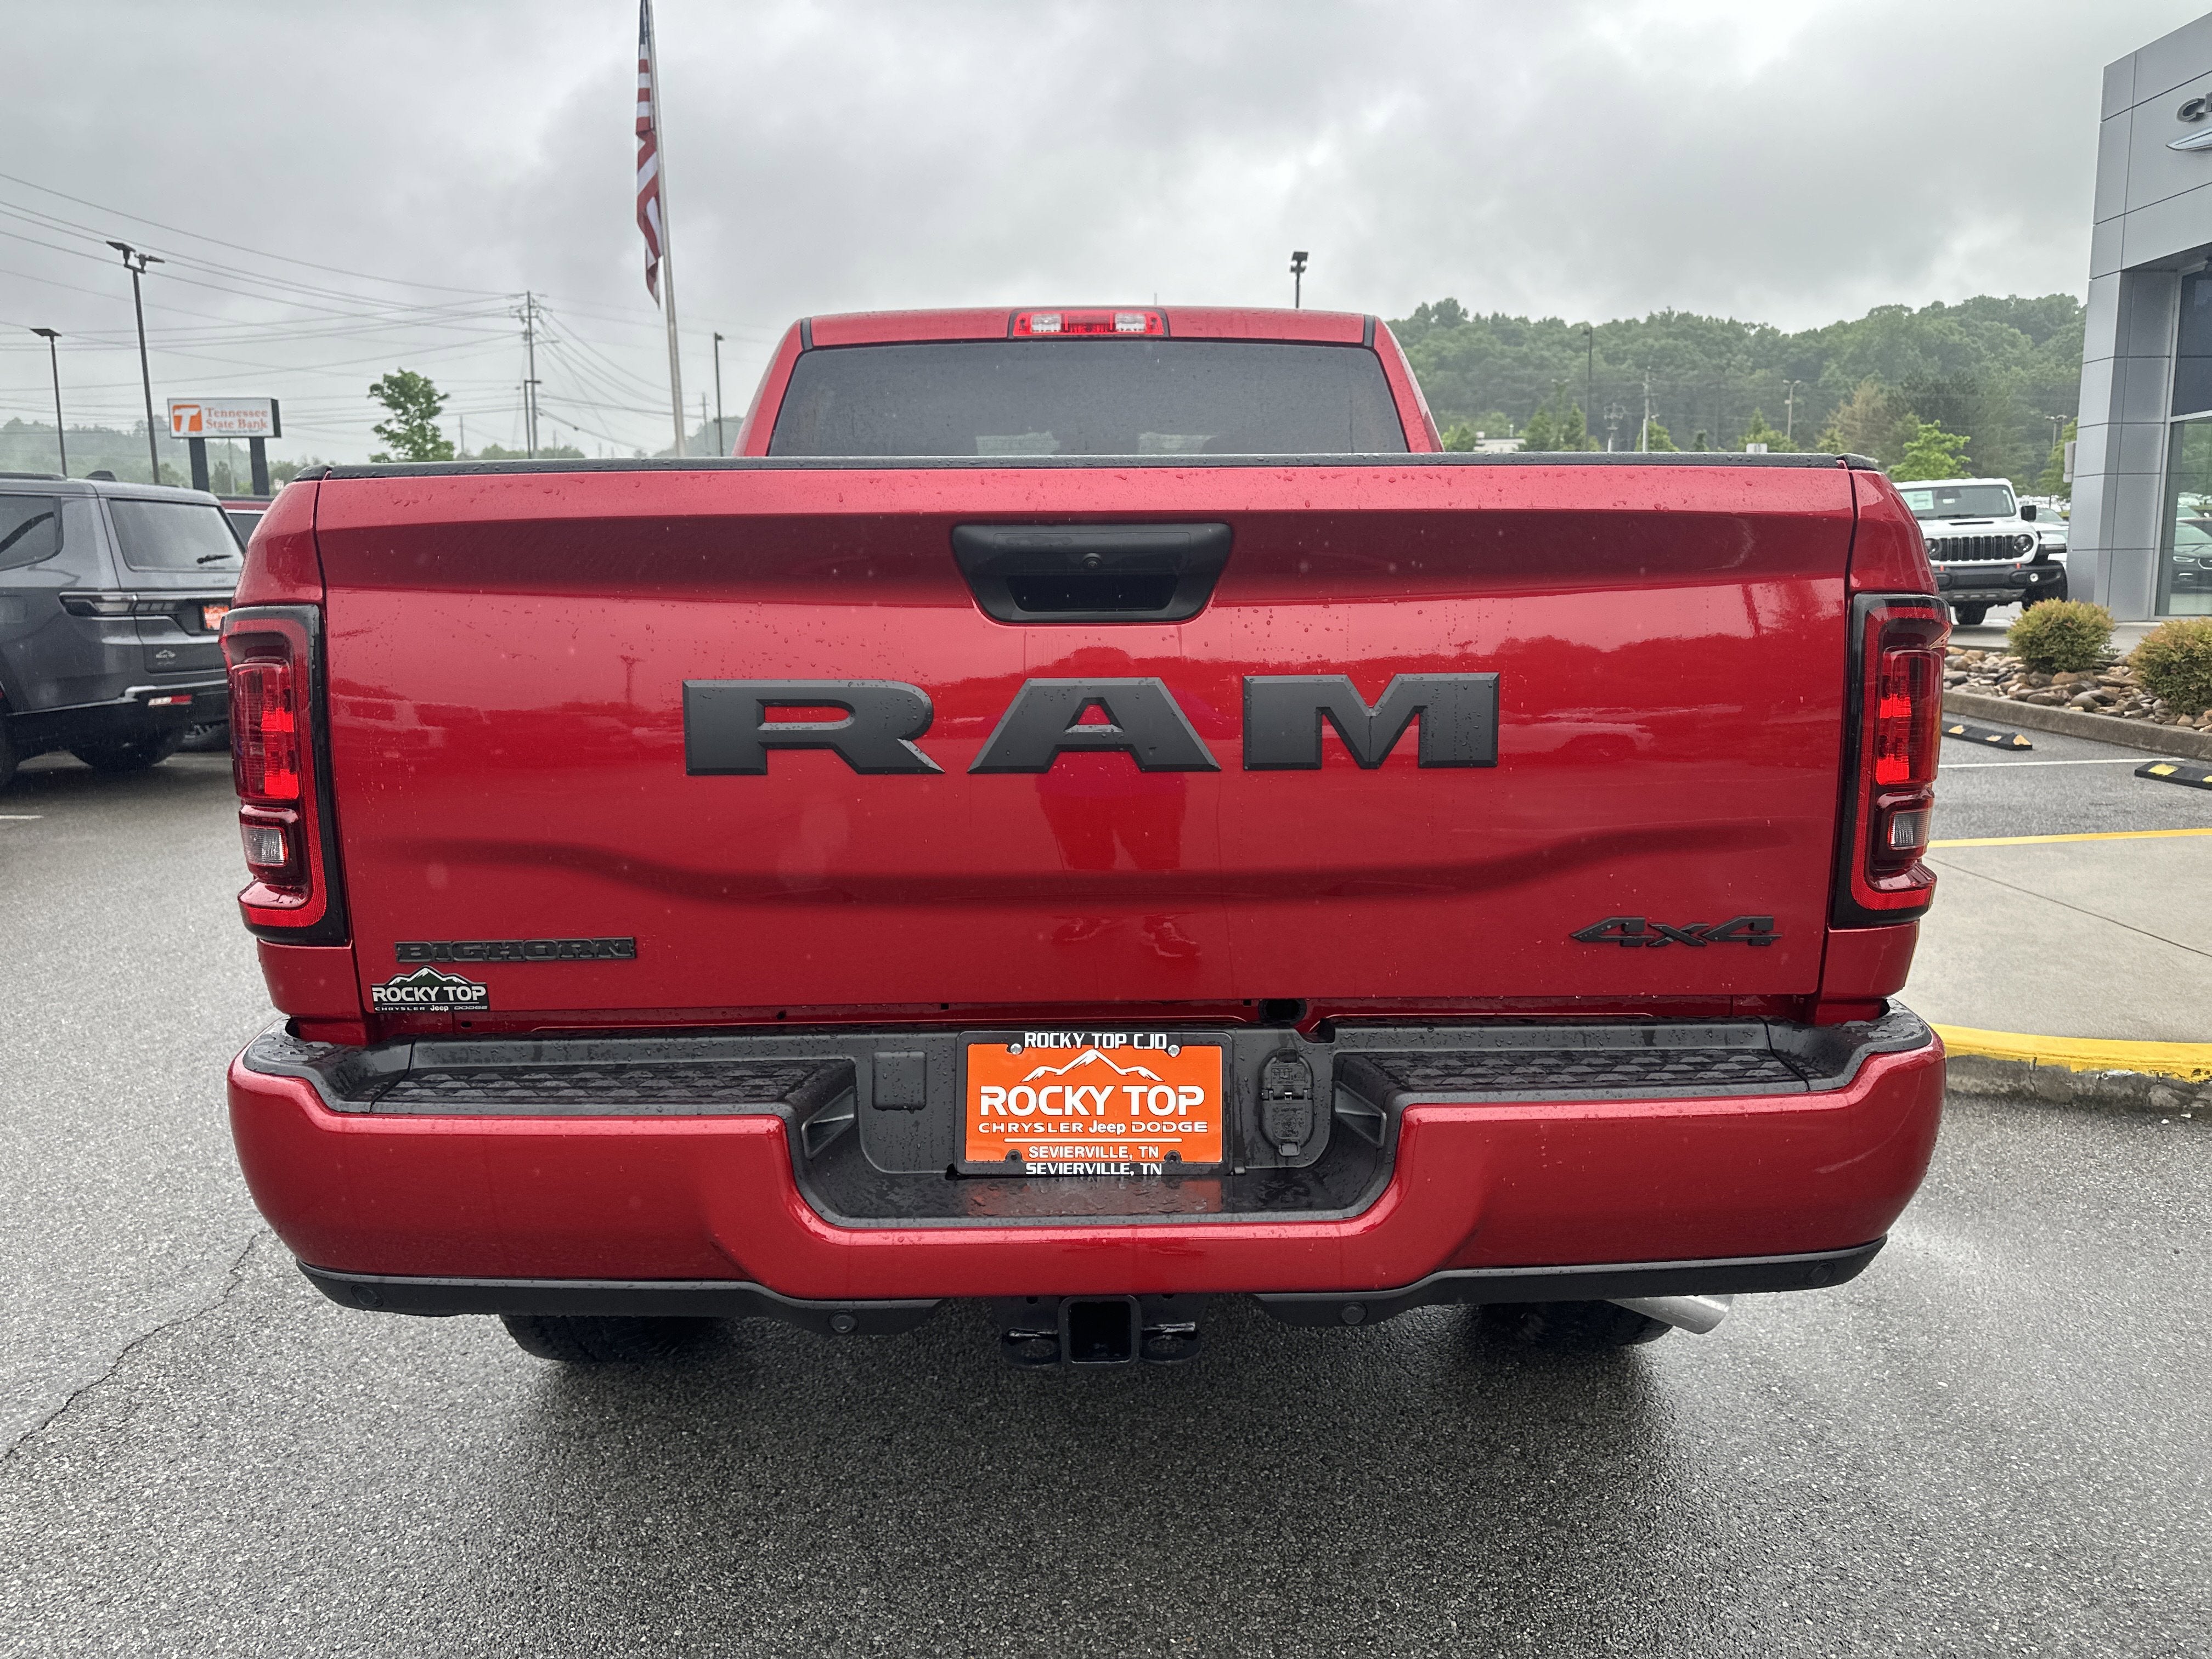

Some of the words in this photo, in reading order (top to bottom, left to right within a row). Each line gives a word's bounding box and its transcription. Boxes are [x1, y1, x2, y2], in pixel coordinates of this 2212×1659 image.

[205, 407, 267, 417] Tennessee
[206, 419, 234, 429] State
[238, 418, 268, 429] Bank
[682, 673, 1499, 775] RAM
[394, 937, 637, 963] BIGHORN
[372, 986, 439, 1002] ROCKY
[443, 985, 487, 1002] TOP
[1024, 1031, 1085, 1049] ROCKY
[1091, 1033, 1127, 1049] TOP
[1132, 1033, 1167, 1050] CJD
[979, 1085, 1116, 1116] ROCKY
[1122, 1085, 1205, 1116] TOP
[978, 1121, 1084, 1133] CHRYSLER
[1087, 1119, 1126, 1136] Jeep
[1131, 1121, 1208, 1133] DODGE
[1028, 1145, 1133, 1161] SEVIERVILLE,
[1137, 1146, 1159, 1159] TN
[1025, 1162, 1135, 1176] SEVIERVILLE,
[1139, 1163, 1163, 1175] TN
